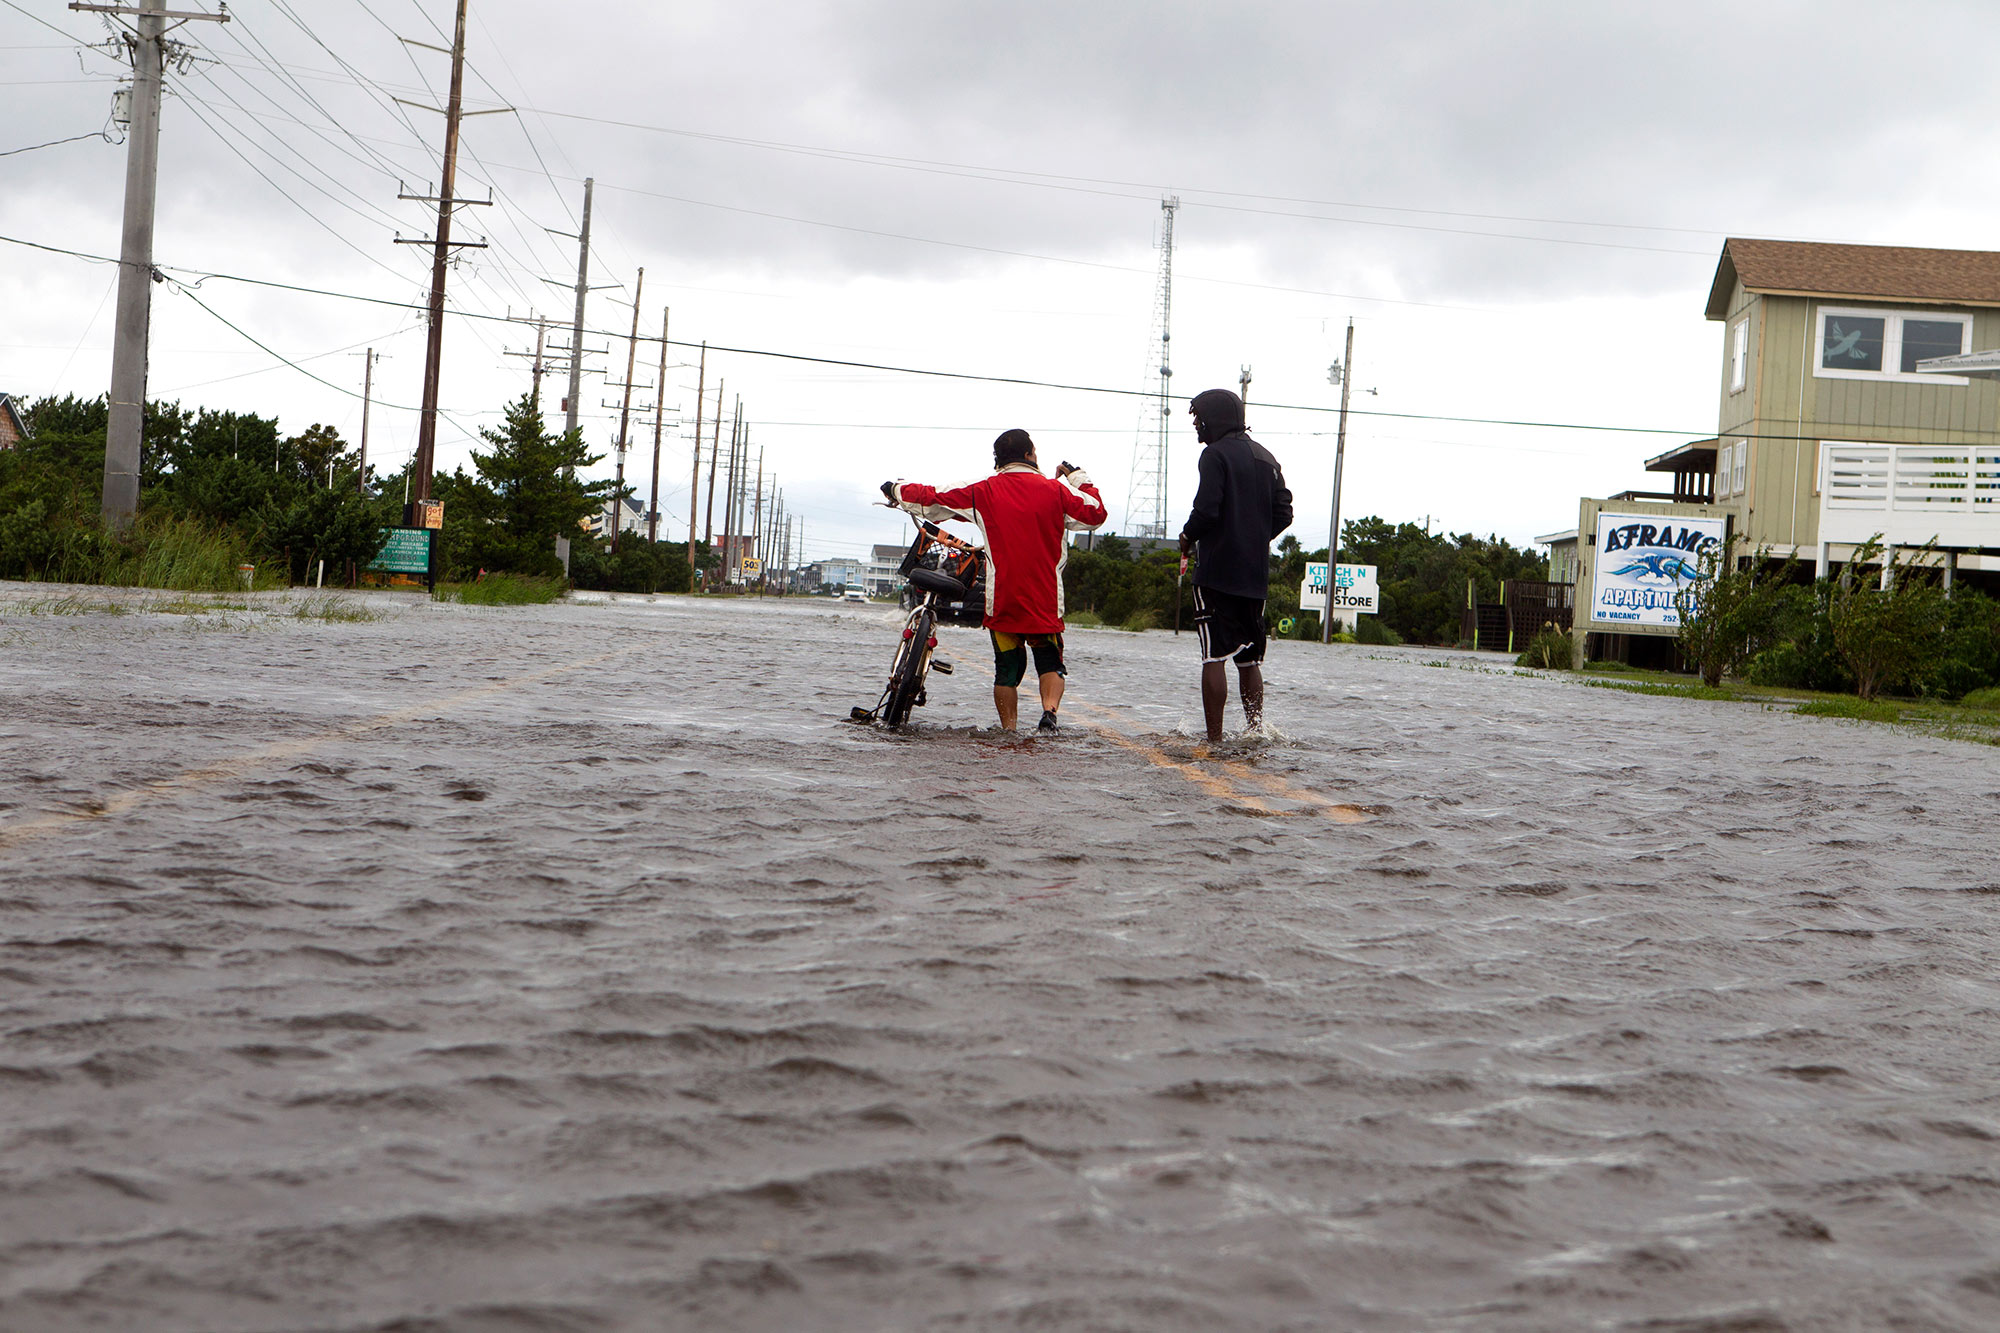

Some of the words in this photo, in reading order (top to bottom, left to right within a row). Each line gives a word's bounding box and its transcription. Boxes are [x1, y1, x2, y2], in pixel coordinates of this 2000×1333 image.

[427, 506, 442, 517] got
[390, 534, 430, 542] MPGROUND
[1358, 568, 1367, 578] N
[1314, 576, 1354, 587] DIHES
[1308, 584, 1349, 595] THFT
[1334, 595, 1373, 607] STORE
[1609, 611, 1641, 620] VACANCY
